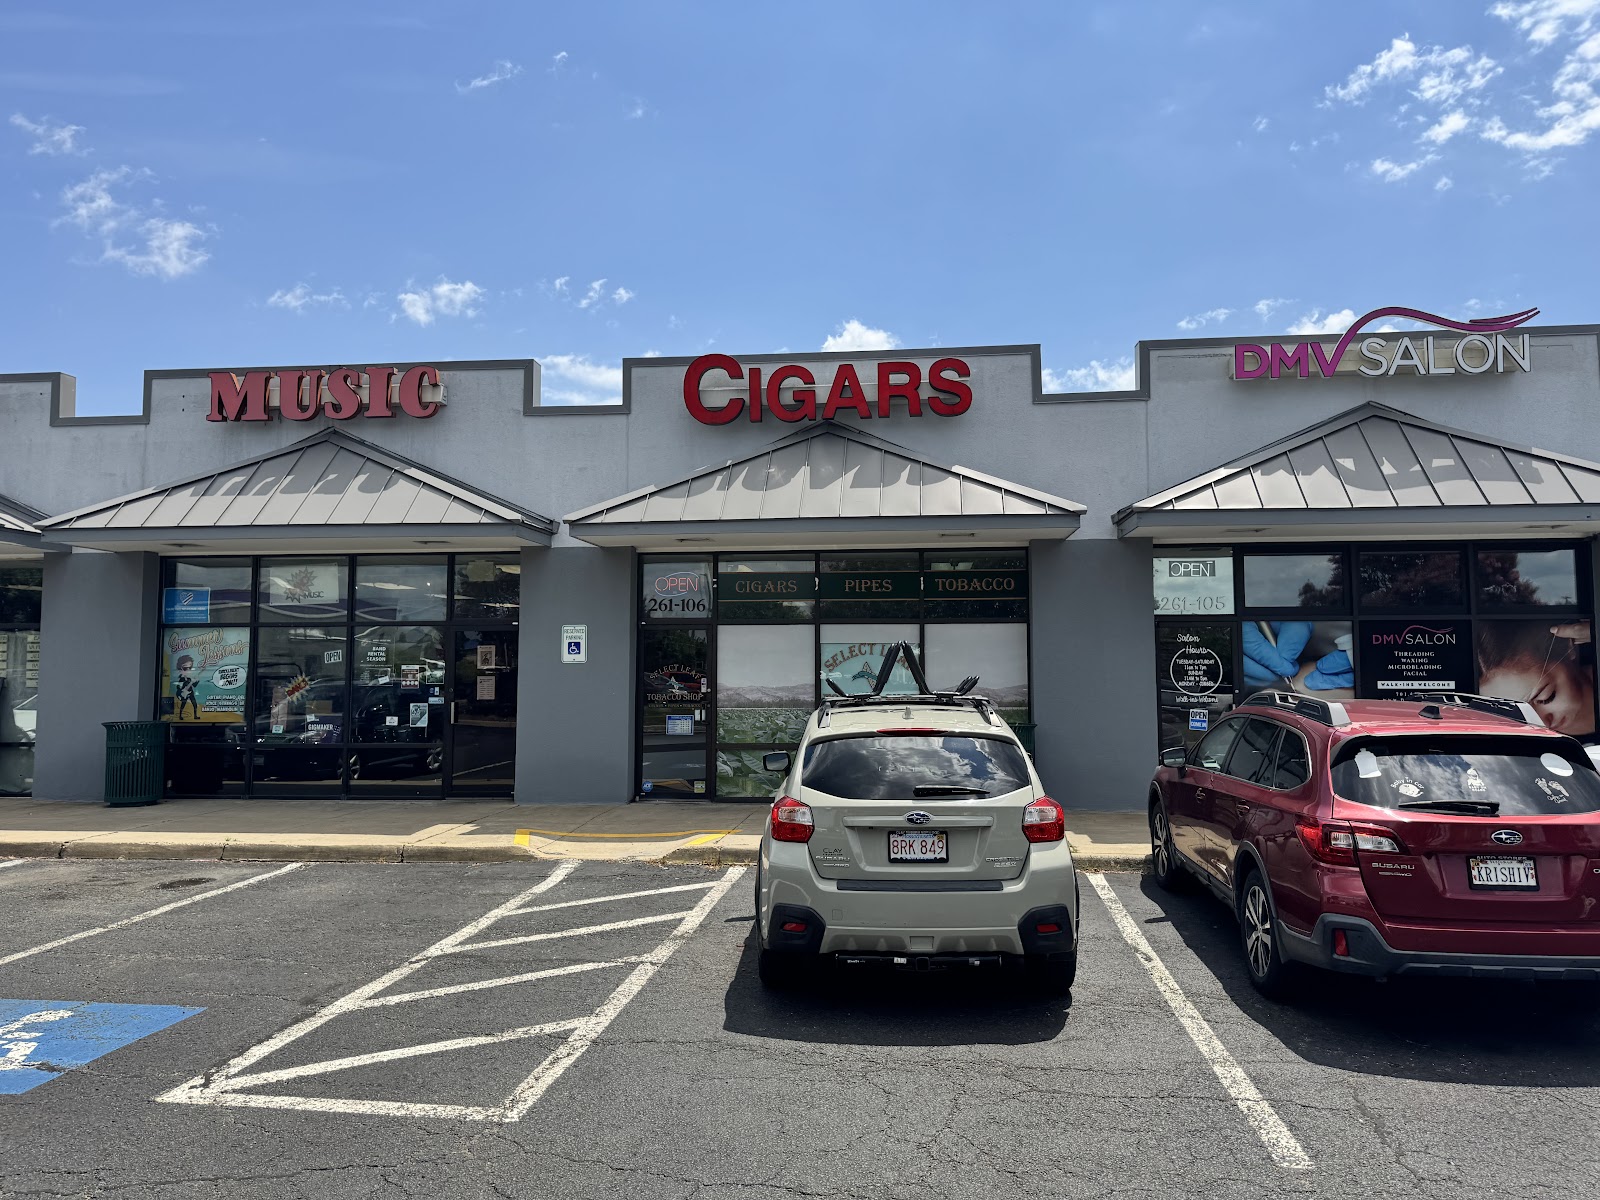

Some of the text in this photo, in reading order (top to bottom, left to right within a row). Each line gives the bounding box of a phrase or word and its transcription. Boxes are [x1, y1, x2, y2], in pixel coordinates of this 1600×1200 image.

[1235, 333, 1531, 379] DMV SALON
[206, 365, 441, 422] MUSIC
[683, 353, 973, 425] CIGARS
[1170, 561, 1210, 577] OPEN
[655, 576, 698, 592] OPEN
[735, 580, 798, 593] CIGARS
[844, 579, 893, 592] PIPES
[935, 578, 1015, 592] TOBACCO
[648, 598, 706, 612] 261-106
[1160, 596, 1226, 611] 261-105
[168, 627, 224, 654] Summer
[1176, 633, 1200, 643] Salon
[1372, 633, 1456, 645] DMV SALON
[325, 651, 341, 662] OPEN
[1185, 645, 1208, 654] Hours
[824, 643, 876, 672] SELECT
[649, 664, 703, 679] SELECT LEAF
[646, 693, 704, 701] TOBACCO SHOP
[1190, 710, 1208, 720] OPEN
[308, 723, 333, 731] GIGMAKER
[891, 839, 945, 855] 8RK 849
[1371, 862, 1415, 870] SUBARU
[1477, 866, 1530, 883] KRISHIV
